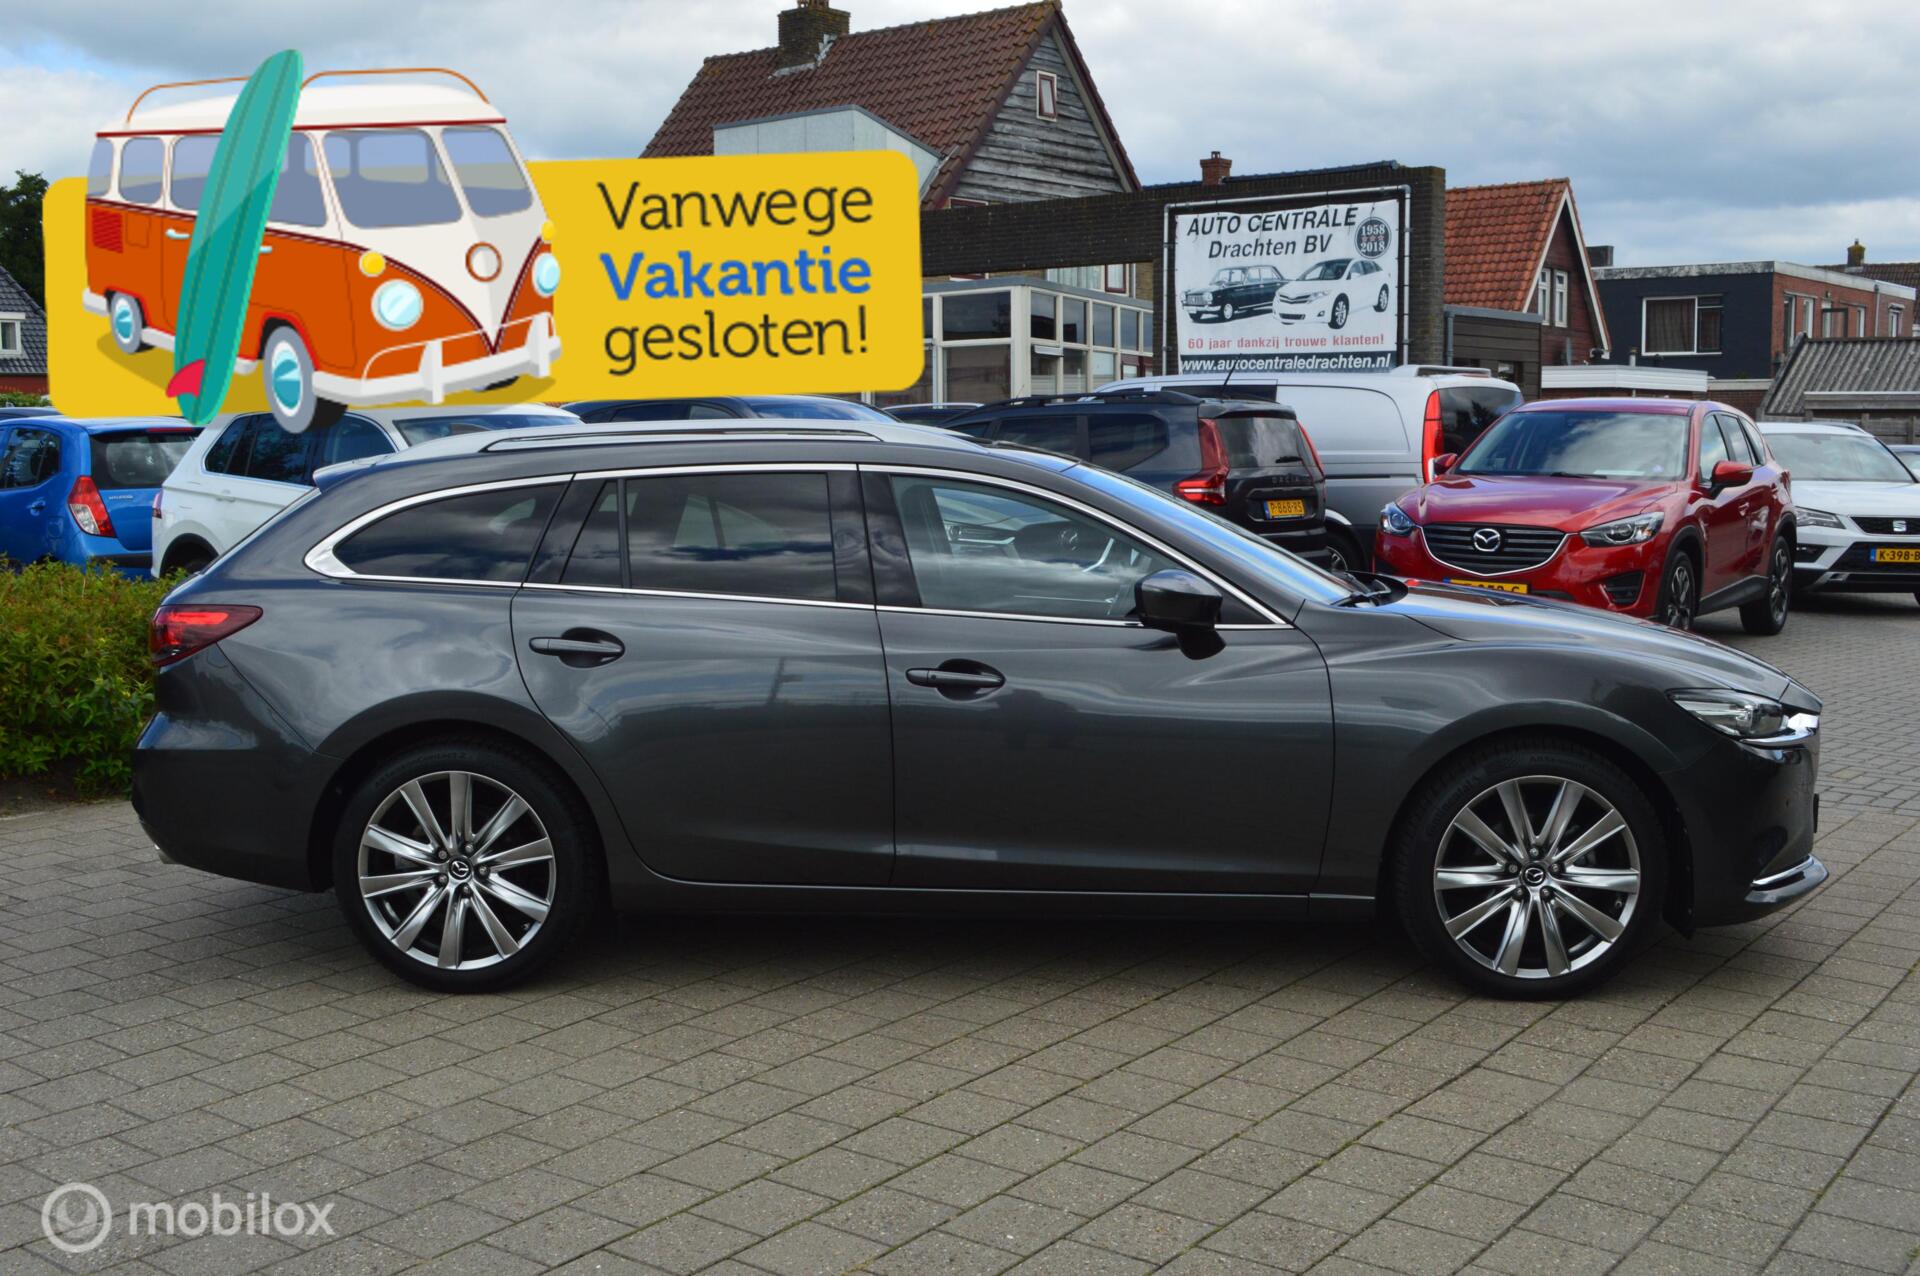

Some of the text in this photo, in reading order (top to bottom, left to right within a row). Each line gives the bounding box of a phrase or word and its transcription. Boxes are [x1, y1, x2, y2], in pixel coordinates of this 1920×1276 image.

[1187, 207, 1358, 236] AUTO CENTRALE
[1361, 223, 1386, 236] 1958
[1209, 233, 1333, 258] Drachten BV
[1360, 240, 1386, 253] 2018
[1188, 334, 1385, 350] 60 jaar dankzij trouwe klanten!
[1181, 353, 1392, 371] www.autocentraledrachten.nl
